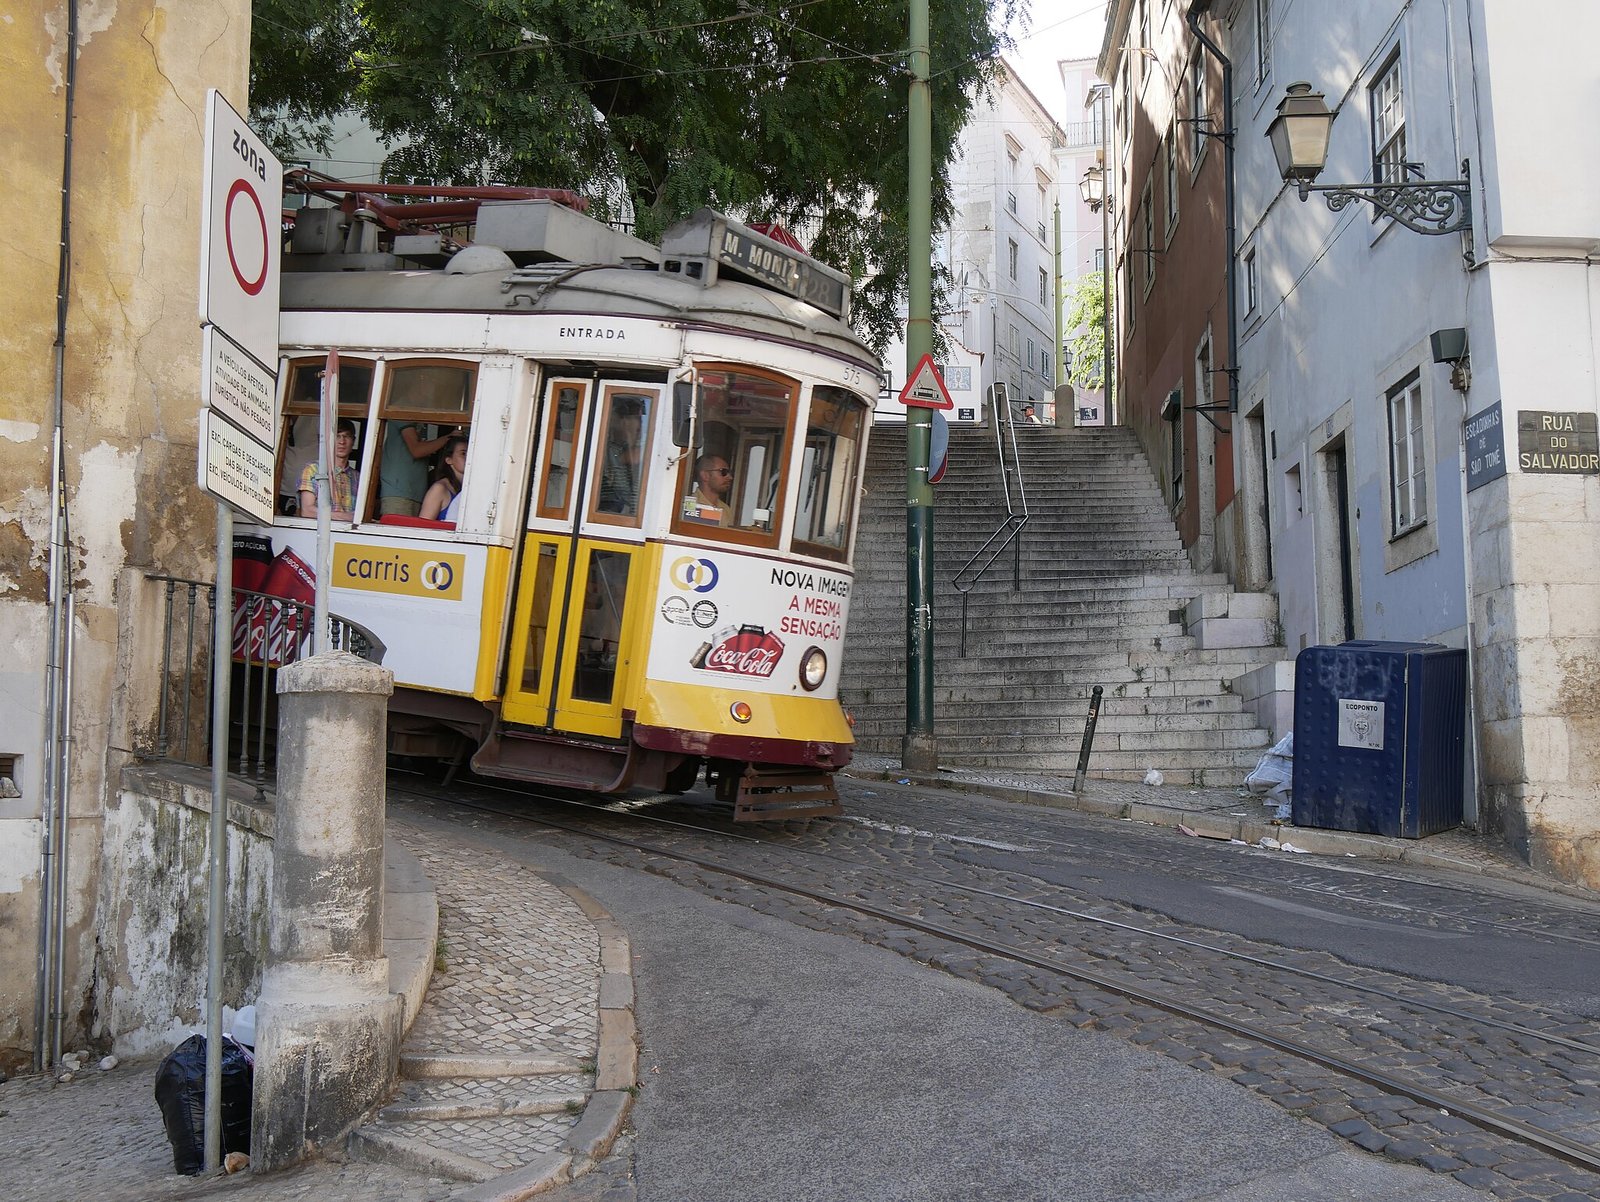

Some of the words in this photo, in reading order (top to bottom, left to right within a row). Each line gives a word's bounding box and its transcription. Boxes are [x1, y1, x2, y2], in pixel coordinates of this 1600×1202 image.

[233, 129, 265, 182] zona
[724, 231, 743, 258] M.
[749, 244, 798, 284] MONIZ
[560, 327, 625, 340] ENTRADA
[216, 365, 240, 392] ATIVIDADE
[240, 384, 247, 398] DE
[247, 373, 264, 394] AFETOS
[843, 367, 860, 385] 575
[240, 400, 250, 417] NÃO
[250, 410, 271, 432] PESADOS
[1465, 409, 1500, 440] ESCADINHAS
[1542, 415, 1574, 431] RUA
[1550, 436, 1568, 448] DO
[222, 438, 241, 458] CARGAS
[246, 453, 271, 478] DESCARGAS
[225, 456, 236, 470] DAS
[1520, 452, 1599, 470] SALVADOR
[244, 484, 272, 510] AUTORIZADOS
[281, 554, 299, 571] SABOR
[346, 554, 410, 583] carris
[771, 568, 814, 591] NOVA
[789, 594, 799, 612] A
[804, 597, 841, 619] MESMA
[780, 616, 841, 641] SENSAÇÃO
